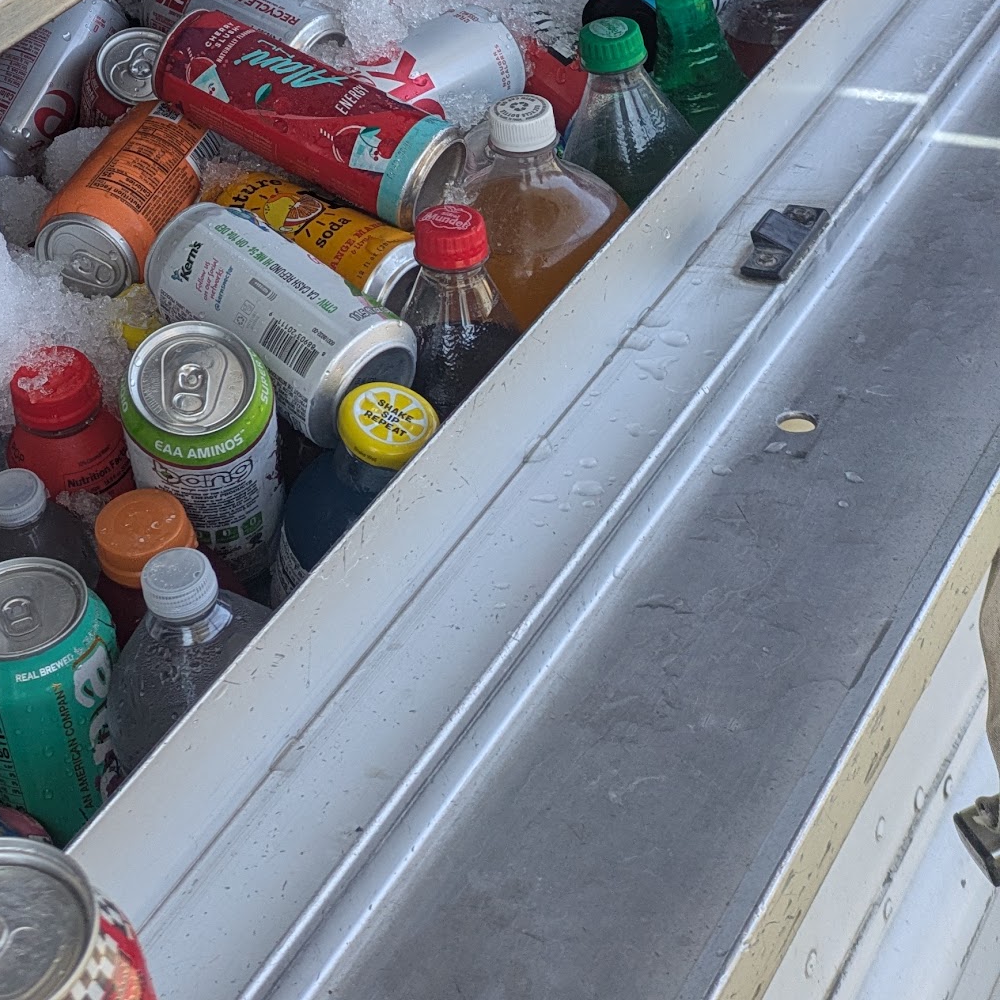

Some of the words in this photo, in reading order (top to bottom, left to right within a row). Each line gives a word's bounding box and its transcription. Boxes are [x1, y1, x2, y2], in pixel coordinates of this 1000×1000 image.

[205, 22, 234, 48] CHERRY
[215, 25, 240, 48] SLUSH
[216, 37, 239, 63] NATURALLY
[233, 47, 349, 89] Alani
[493, 51, 505, 75] SUGAR
[334, 84, 370, 115] ENERGY
[115, 189, 142, 210] Nutrition
[214, 223, 229, 236] DEP
[316, 217, 352, 249] soda
[422, 212, 472, 230] Mundet
[179, 240, 204, 282] Kern's
[330, 239, 354, 270] ANGE
[195, 270, 208, 293] Follow
[268, 263, 297, 285] REFUND
[292, 279, 311, 295] CASH
[377, 399, 415, 424] SHAKE
[380, 410, 401, 424] SIP
[363, 410, 408, 438] REPEAT
[154, 440, 183, 459] EAA
[187, 434, 244, 460] AMINOS
[67, 466, 110, 488] Nutrition
[15, 671, 40, 683] REAL
[51, 682, 72, 736] COMPANY
[64, 739, 87, 794] AMERICAN
[84, 793, 95, 809] AN
